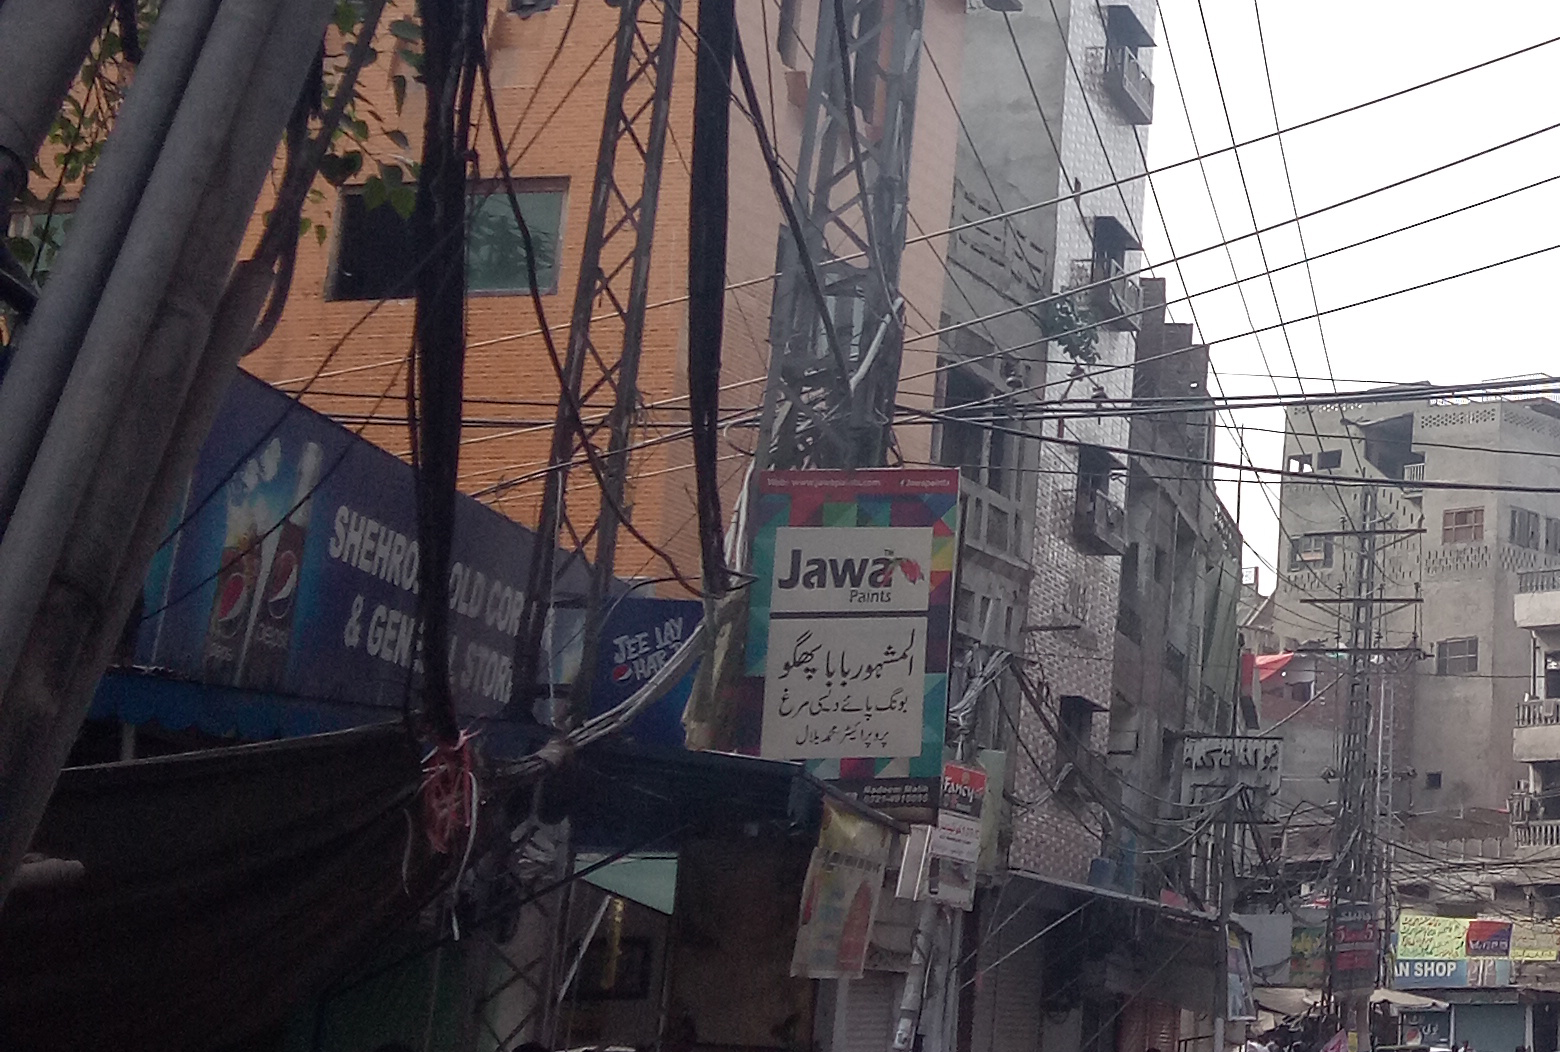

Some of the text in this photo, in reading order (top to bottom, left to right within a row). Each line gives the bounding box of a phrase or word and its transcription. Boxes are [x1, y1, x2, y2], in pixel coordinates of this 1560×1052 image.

[329, 504, 421, 595] SHEHRO
[449, 561, 486, 619] OLD
[778, 549, 894, 590] Jawa
[849, 590, 892, 603] Paints
[343, 593, 365, 648] &
[613, 617, 684, 664] JEE LAY
[632, 650, 669, 681] HAR
[1413, 962, 1458, 978] SHOP
